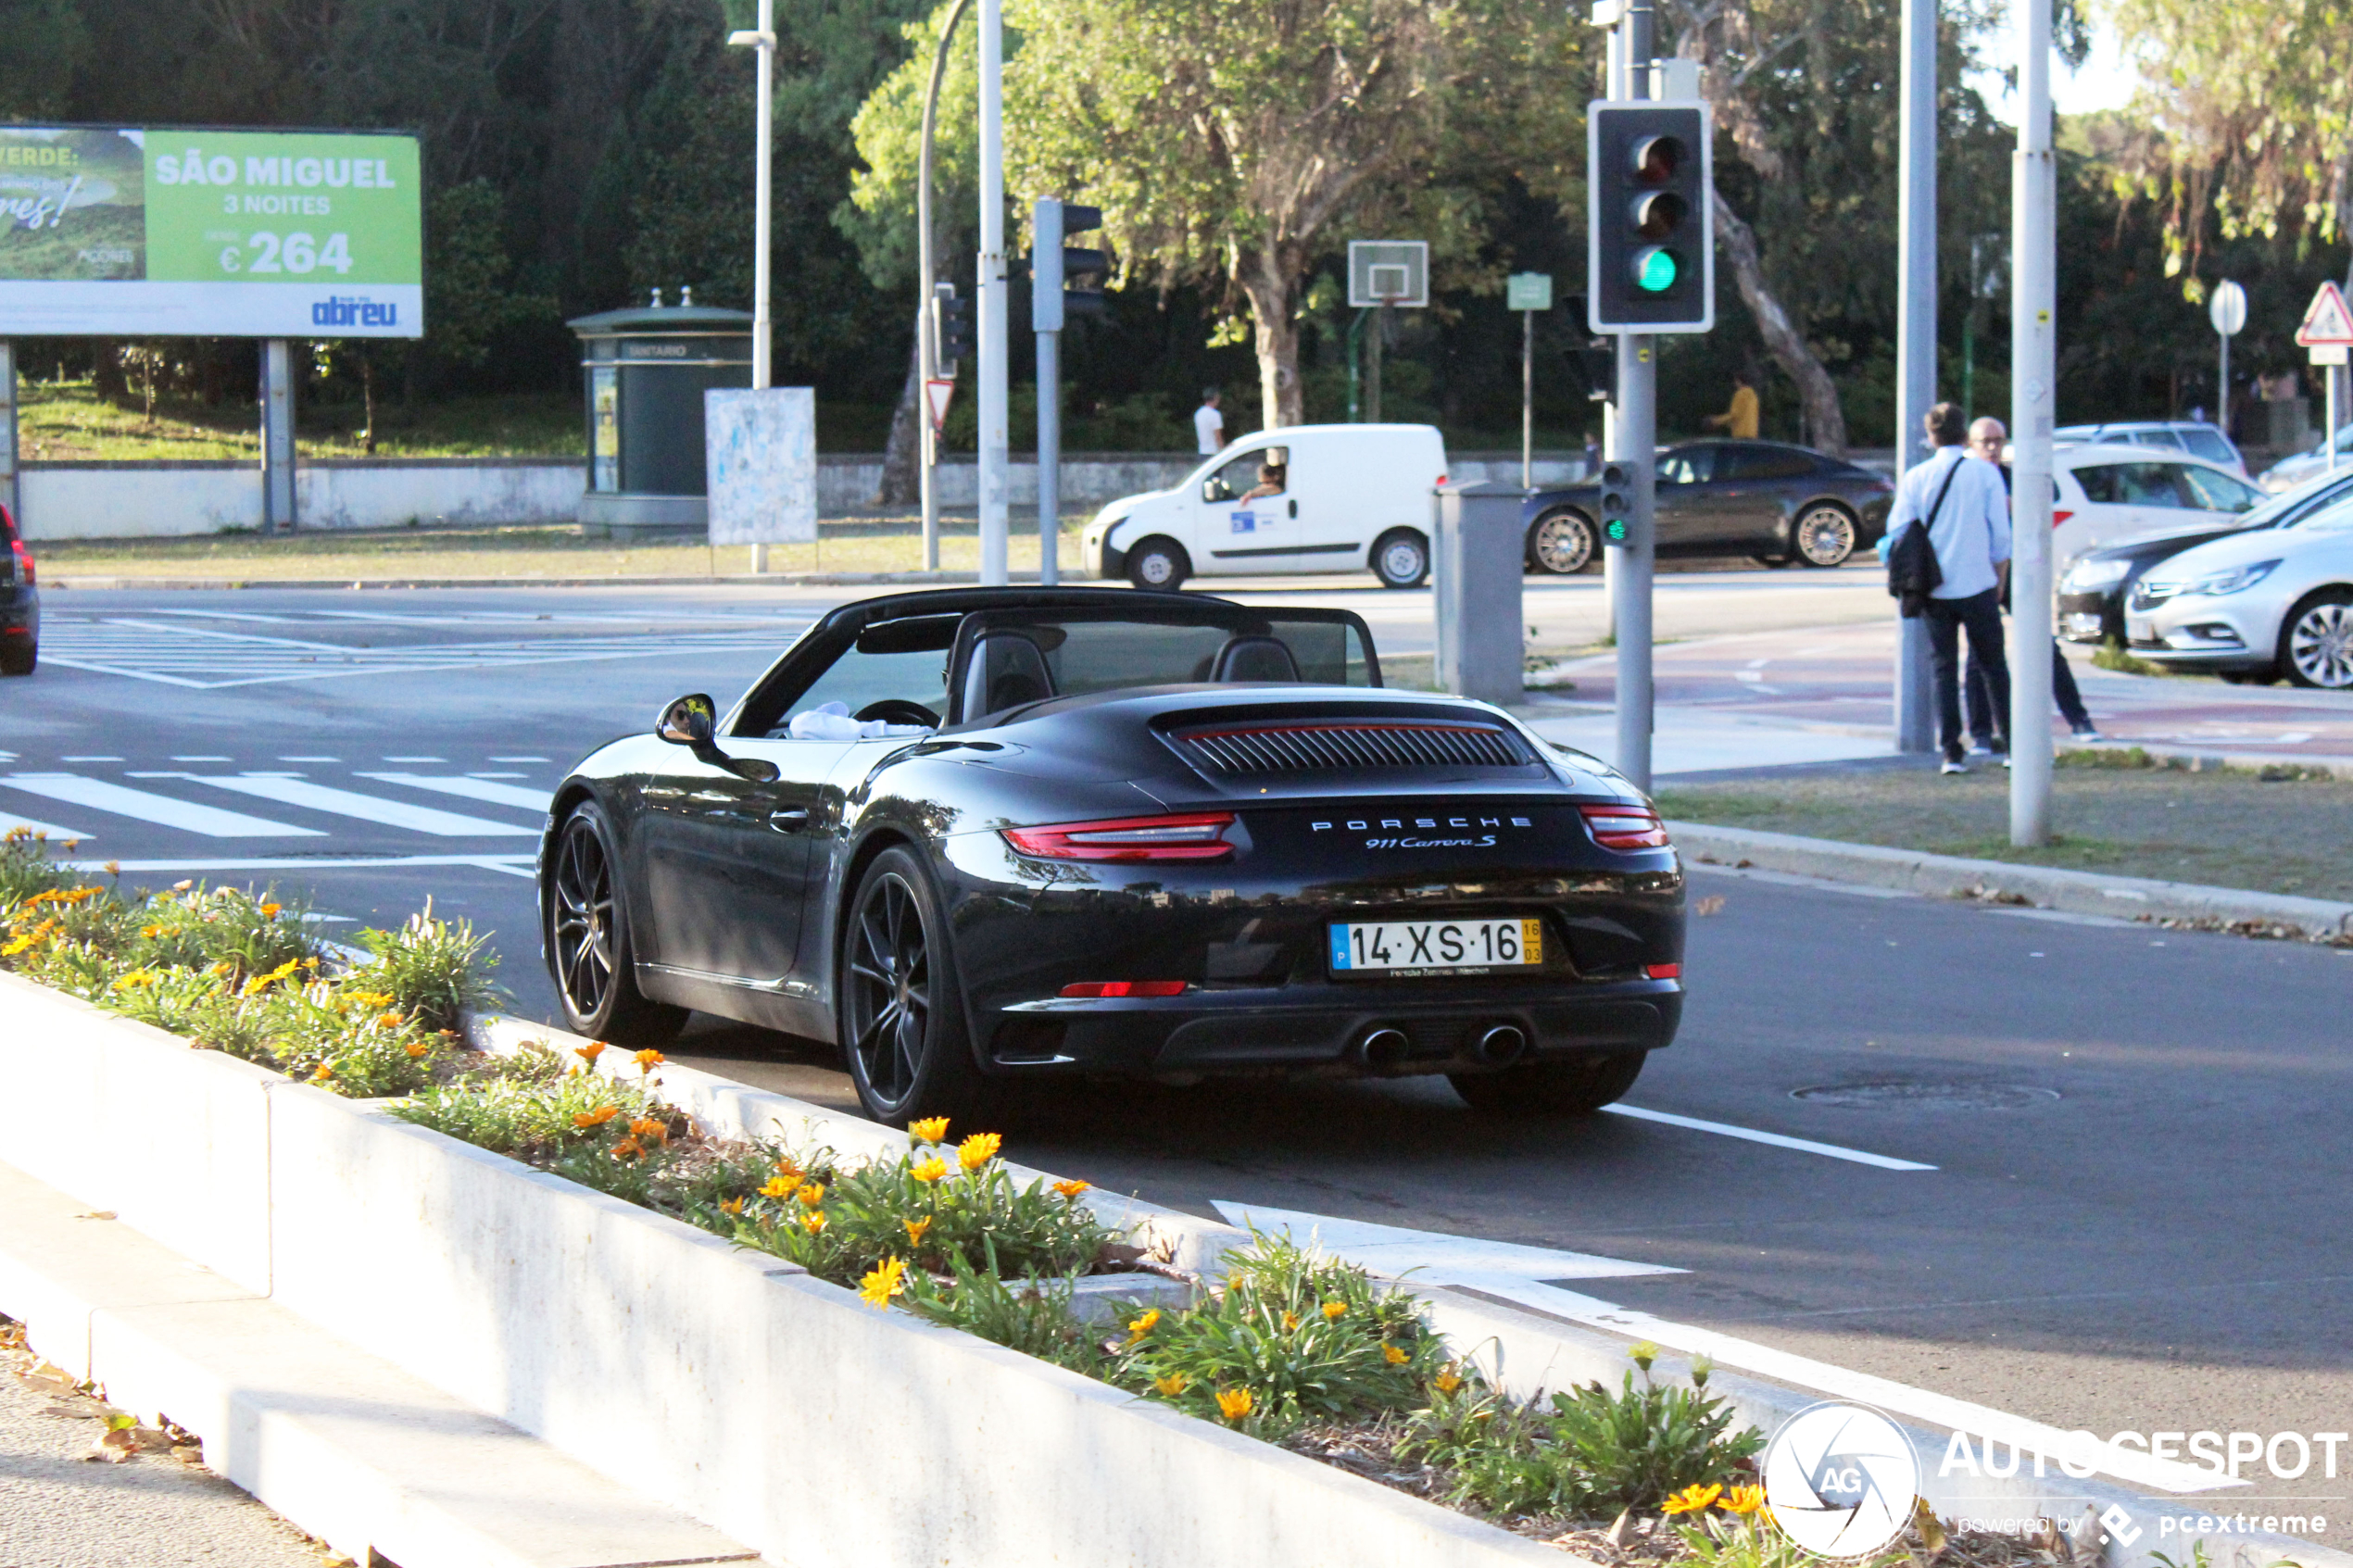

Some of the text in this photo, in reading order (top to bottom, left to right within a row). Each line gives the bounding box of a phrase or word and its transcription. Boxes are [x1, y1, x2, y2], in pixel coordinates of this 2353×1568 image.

[156, 148, 396, 189] SÃO MIGUEL
[224, 195, 331, 215] 3 NOITES
[220, 231, 353, 274] € 264
[311, 295, 397, 327] abreu
[1311, 817, 1532, 832] PORSCHE
[1365, 834, 1497, 849] 911 Carrera S
[1524, 923, 1540, 936] 16
[1337, 951, 1346, 962] P
[1524, 948, 1541, 961] 03
